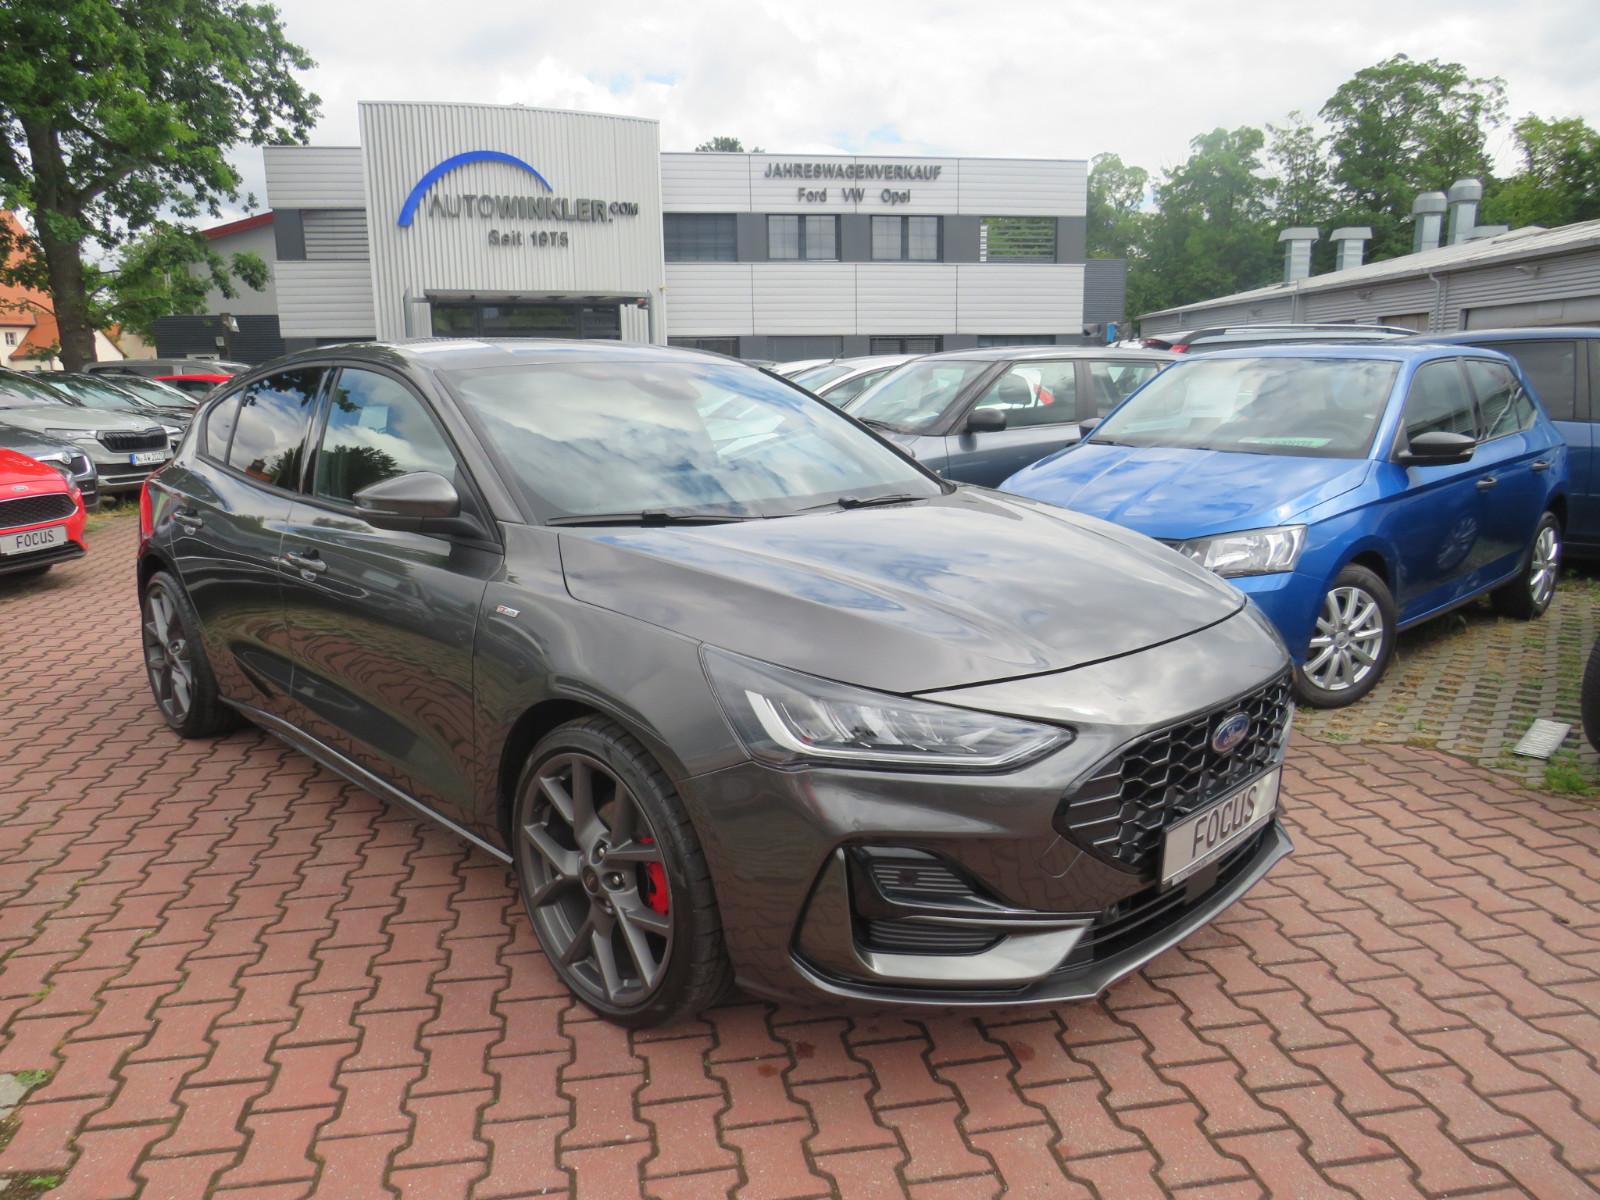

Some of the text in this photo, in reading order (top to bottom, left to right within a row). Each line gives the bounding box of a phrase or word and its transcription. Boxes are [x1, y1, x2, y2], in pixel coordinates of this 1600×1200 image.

[764, 163, 942, 181] JAHRESWAGENVERKAUF
[797, 187, 910, 206] Ford VW Opel
[488, 229, 523, 247] Seit
[16, 530, 54, 548] FOCUS
[1192, 785, 1257, 858] FOCUS
